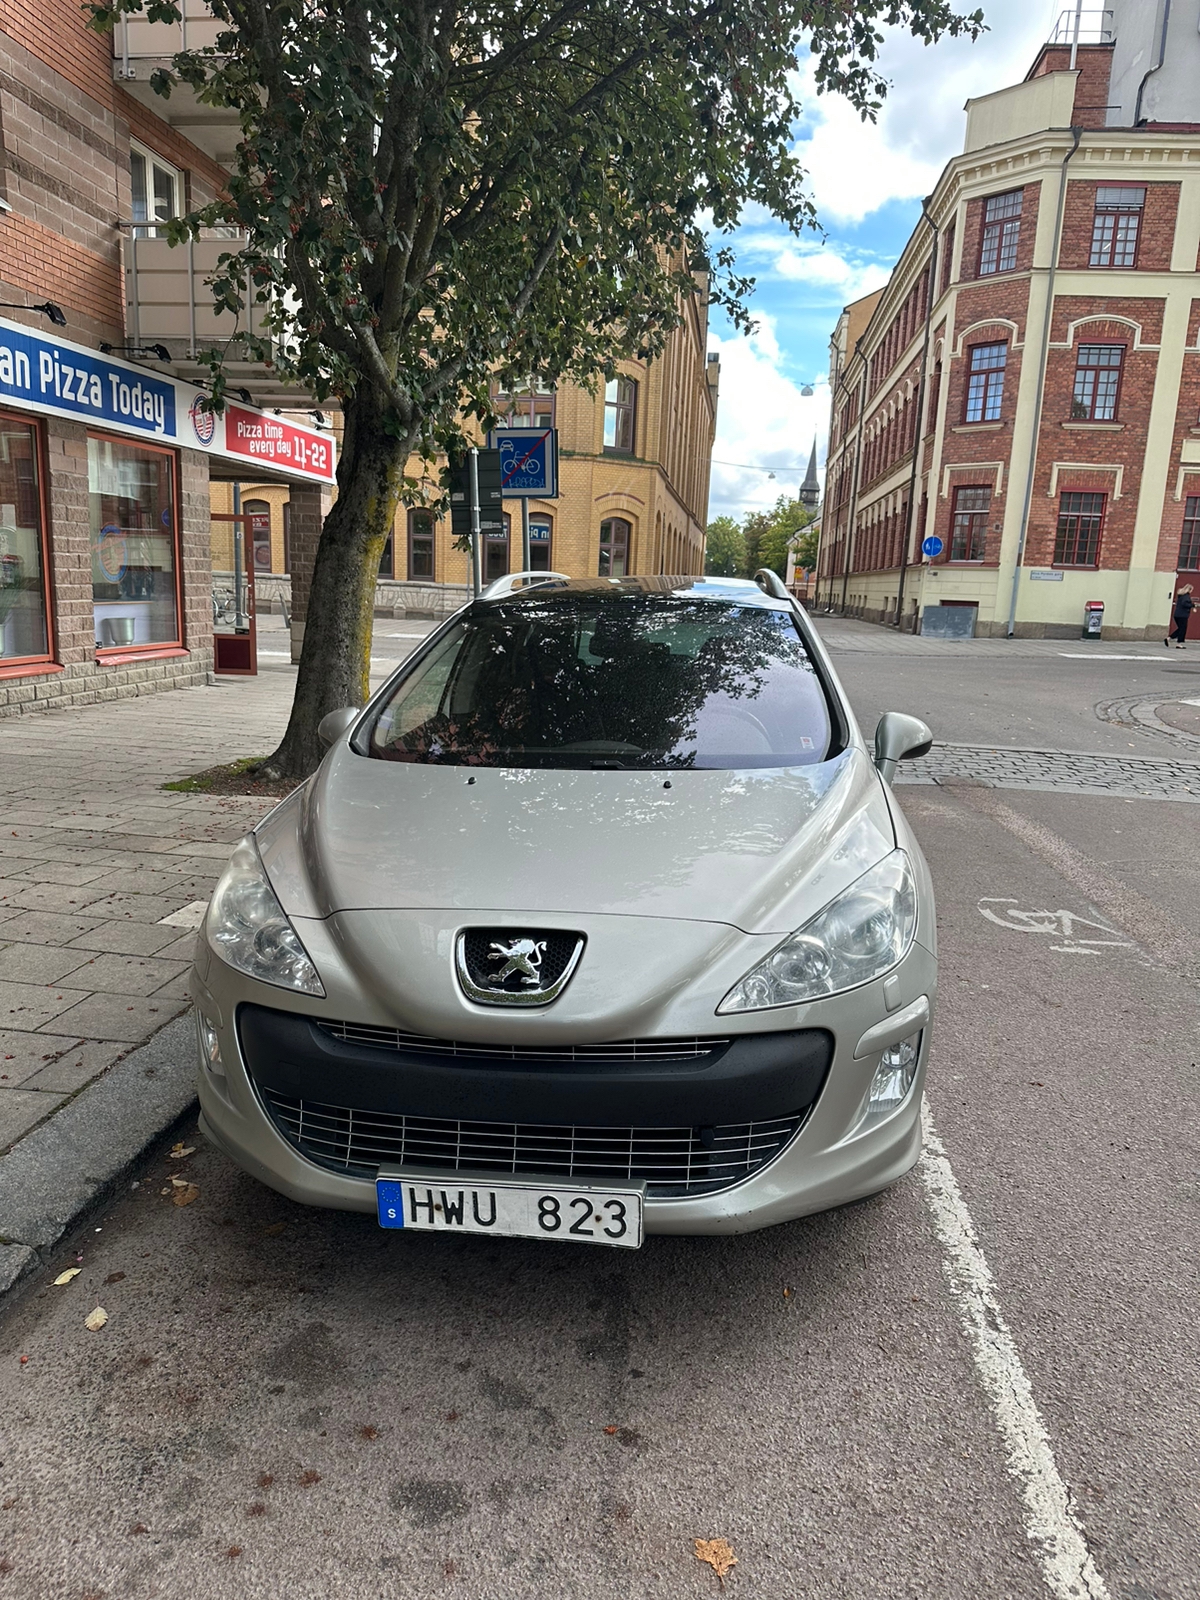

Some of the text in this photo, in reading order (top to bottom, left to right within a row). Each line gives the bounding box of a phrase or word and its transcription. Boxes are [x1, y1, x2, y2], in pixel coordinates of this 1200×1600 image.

[39, 350, 102, 408] Pizza
[108, 372, 165, 434] Today
[237, 420, 283, 438] Pizza time
[249, 439, 292, 457] every day
[293, 435, 327, 469] 11-22
[387, 1208, 397, 1219] S
[409, 1187, 627, 1238] HWU 823
